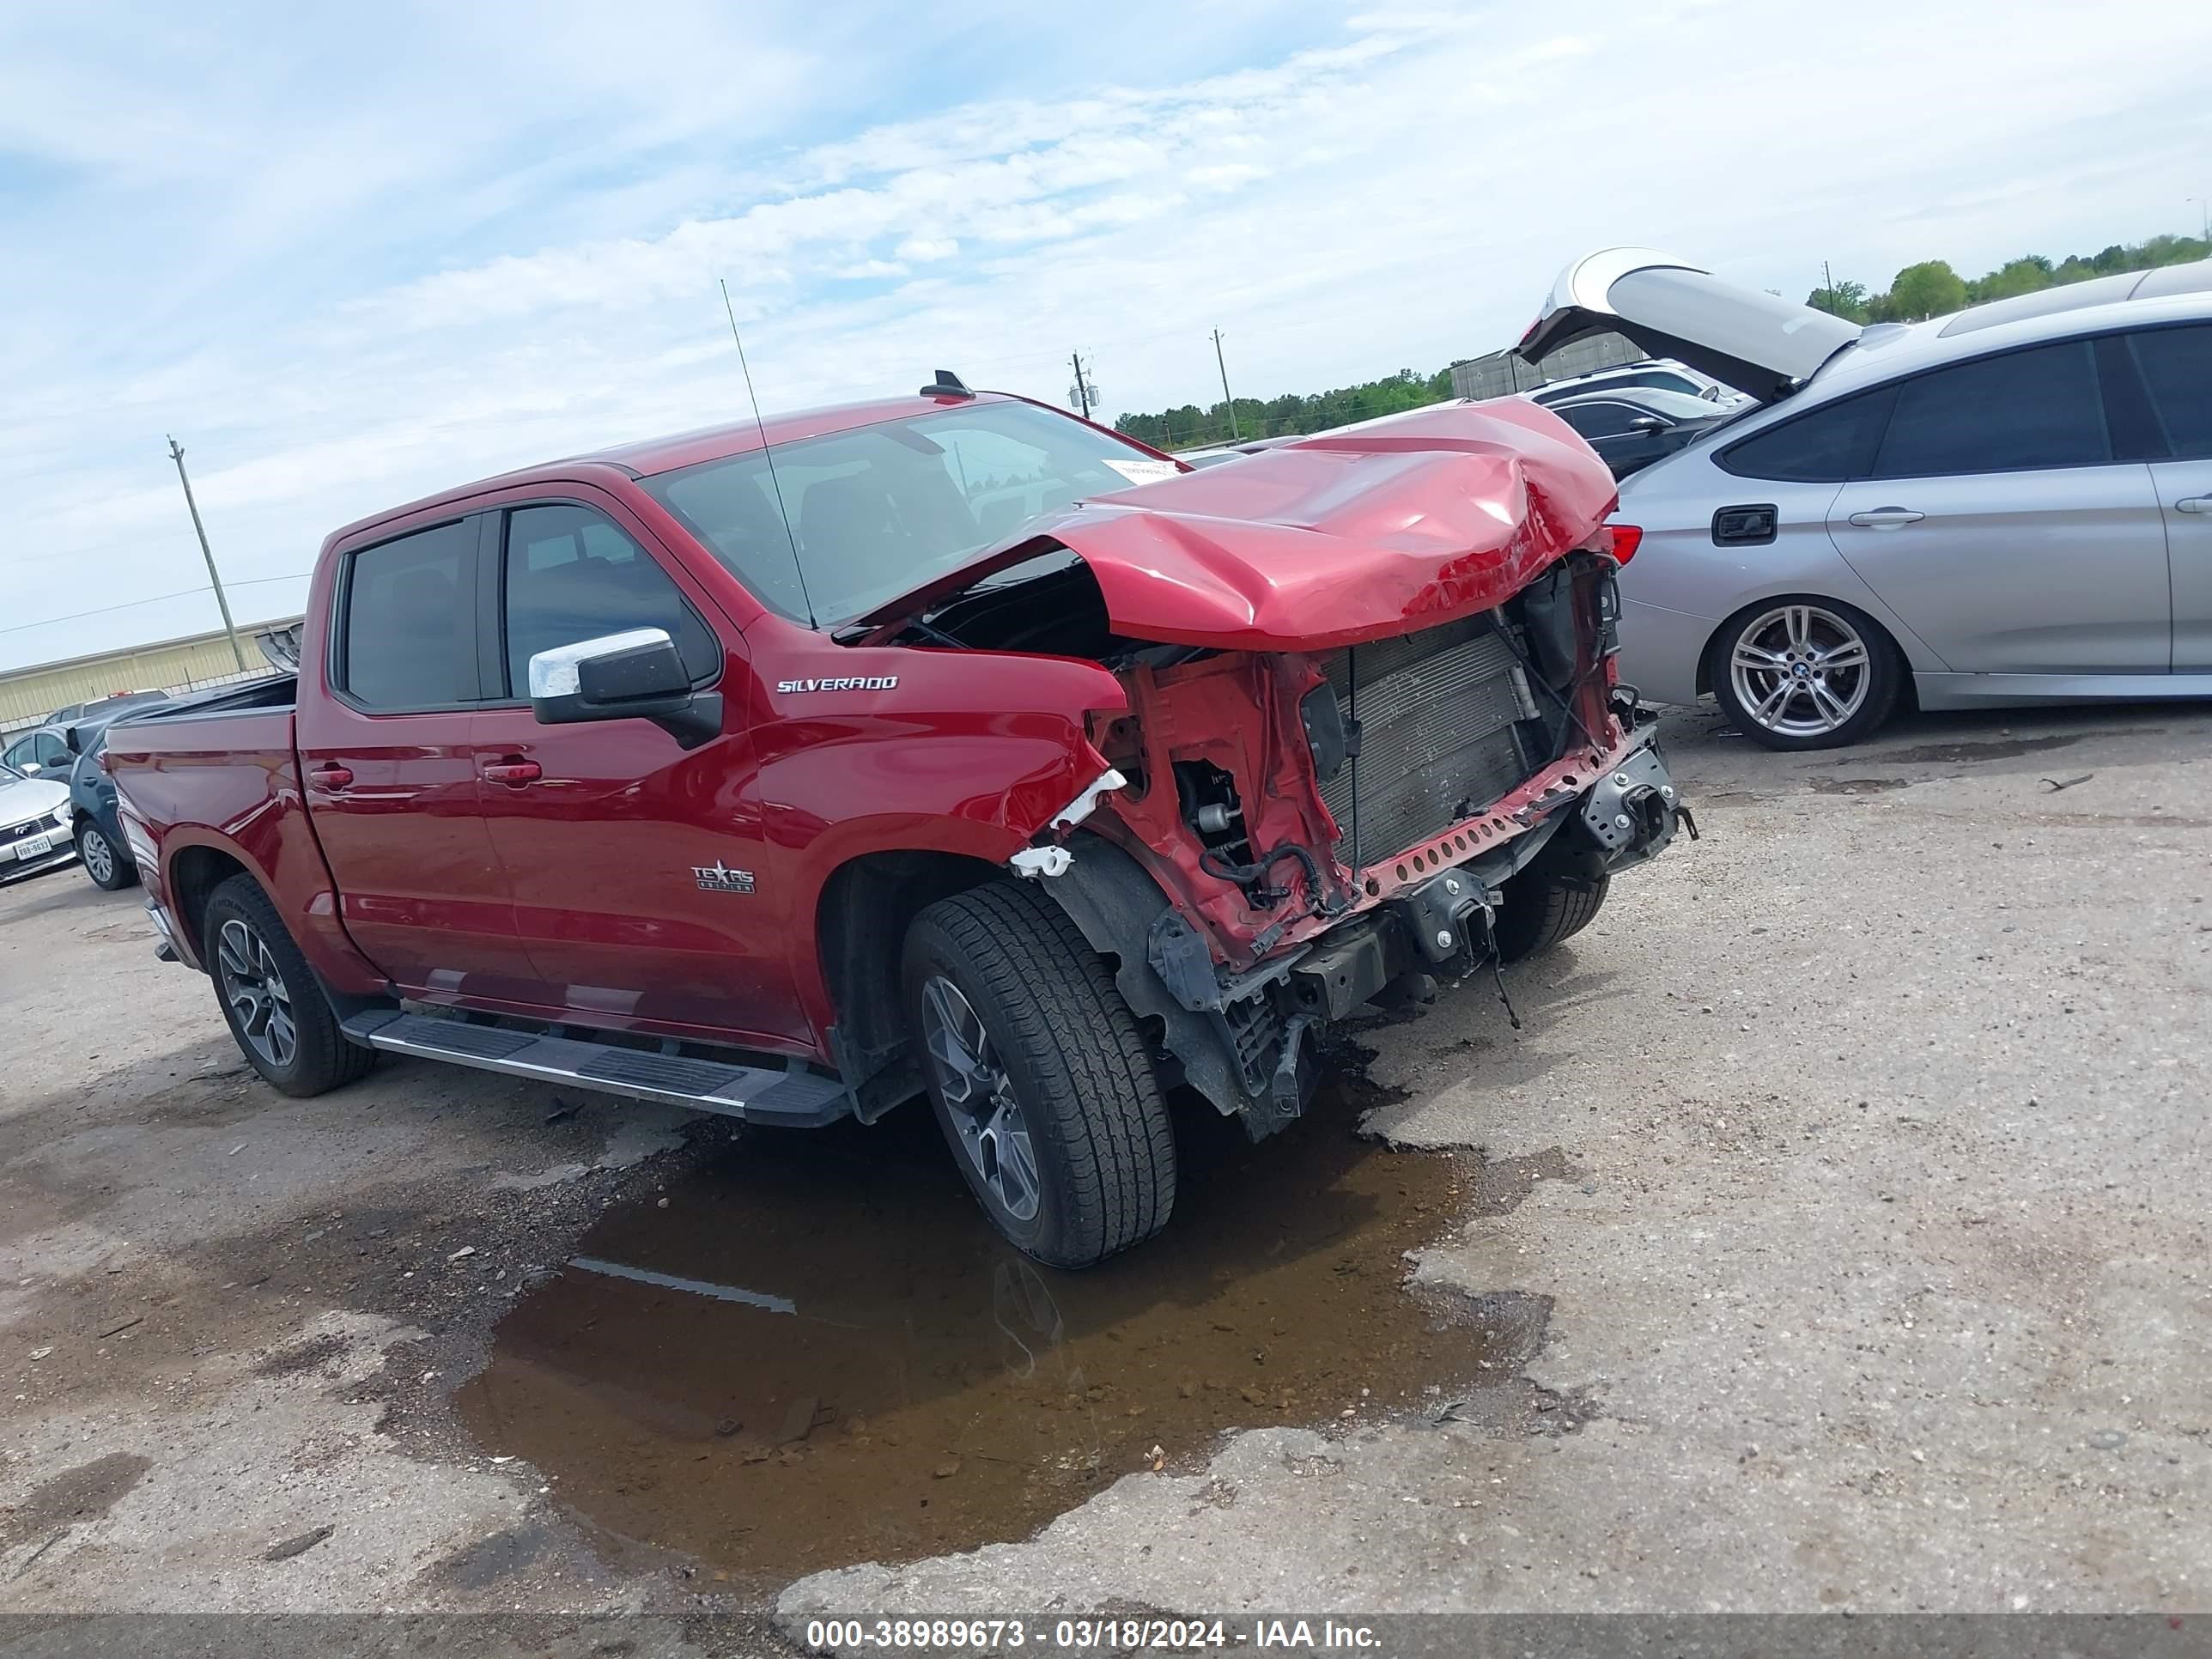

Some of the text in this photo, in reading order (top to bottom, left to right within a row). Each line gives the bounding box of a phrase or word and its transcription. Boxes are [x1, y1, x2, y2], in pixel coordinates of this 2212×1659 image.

[776, 676, 898, 693] SILVERADO
[690, 859, 755, 884] TEXAS
[700, 882, 751, 891] EDITION
